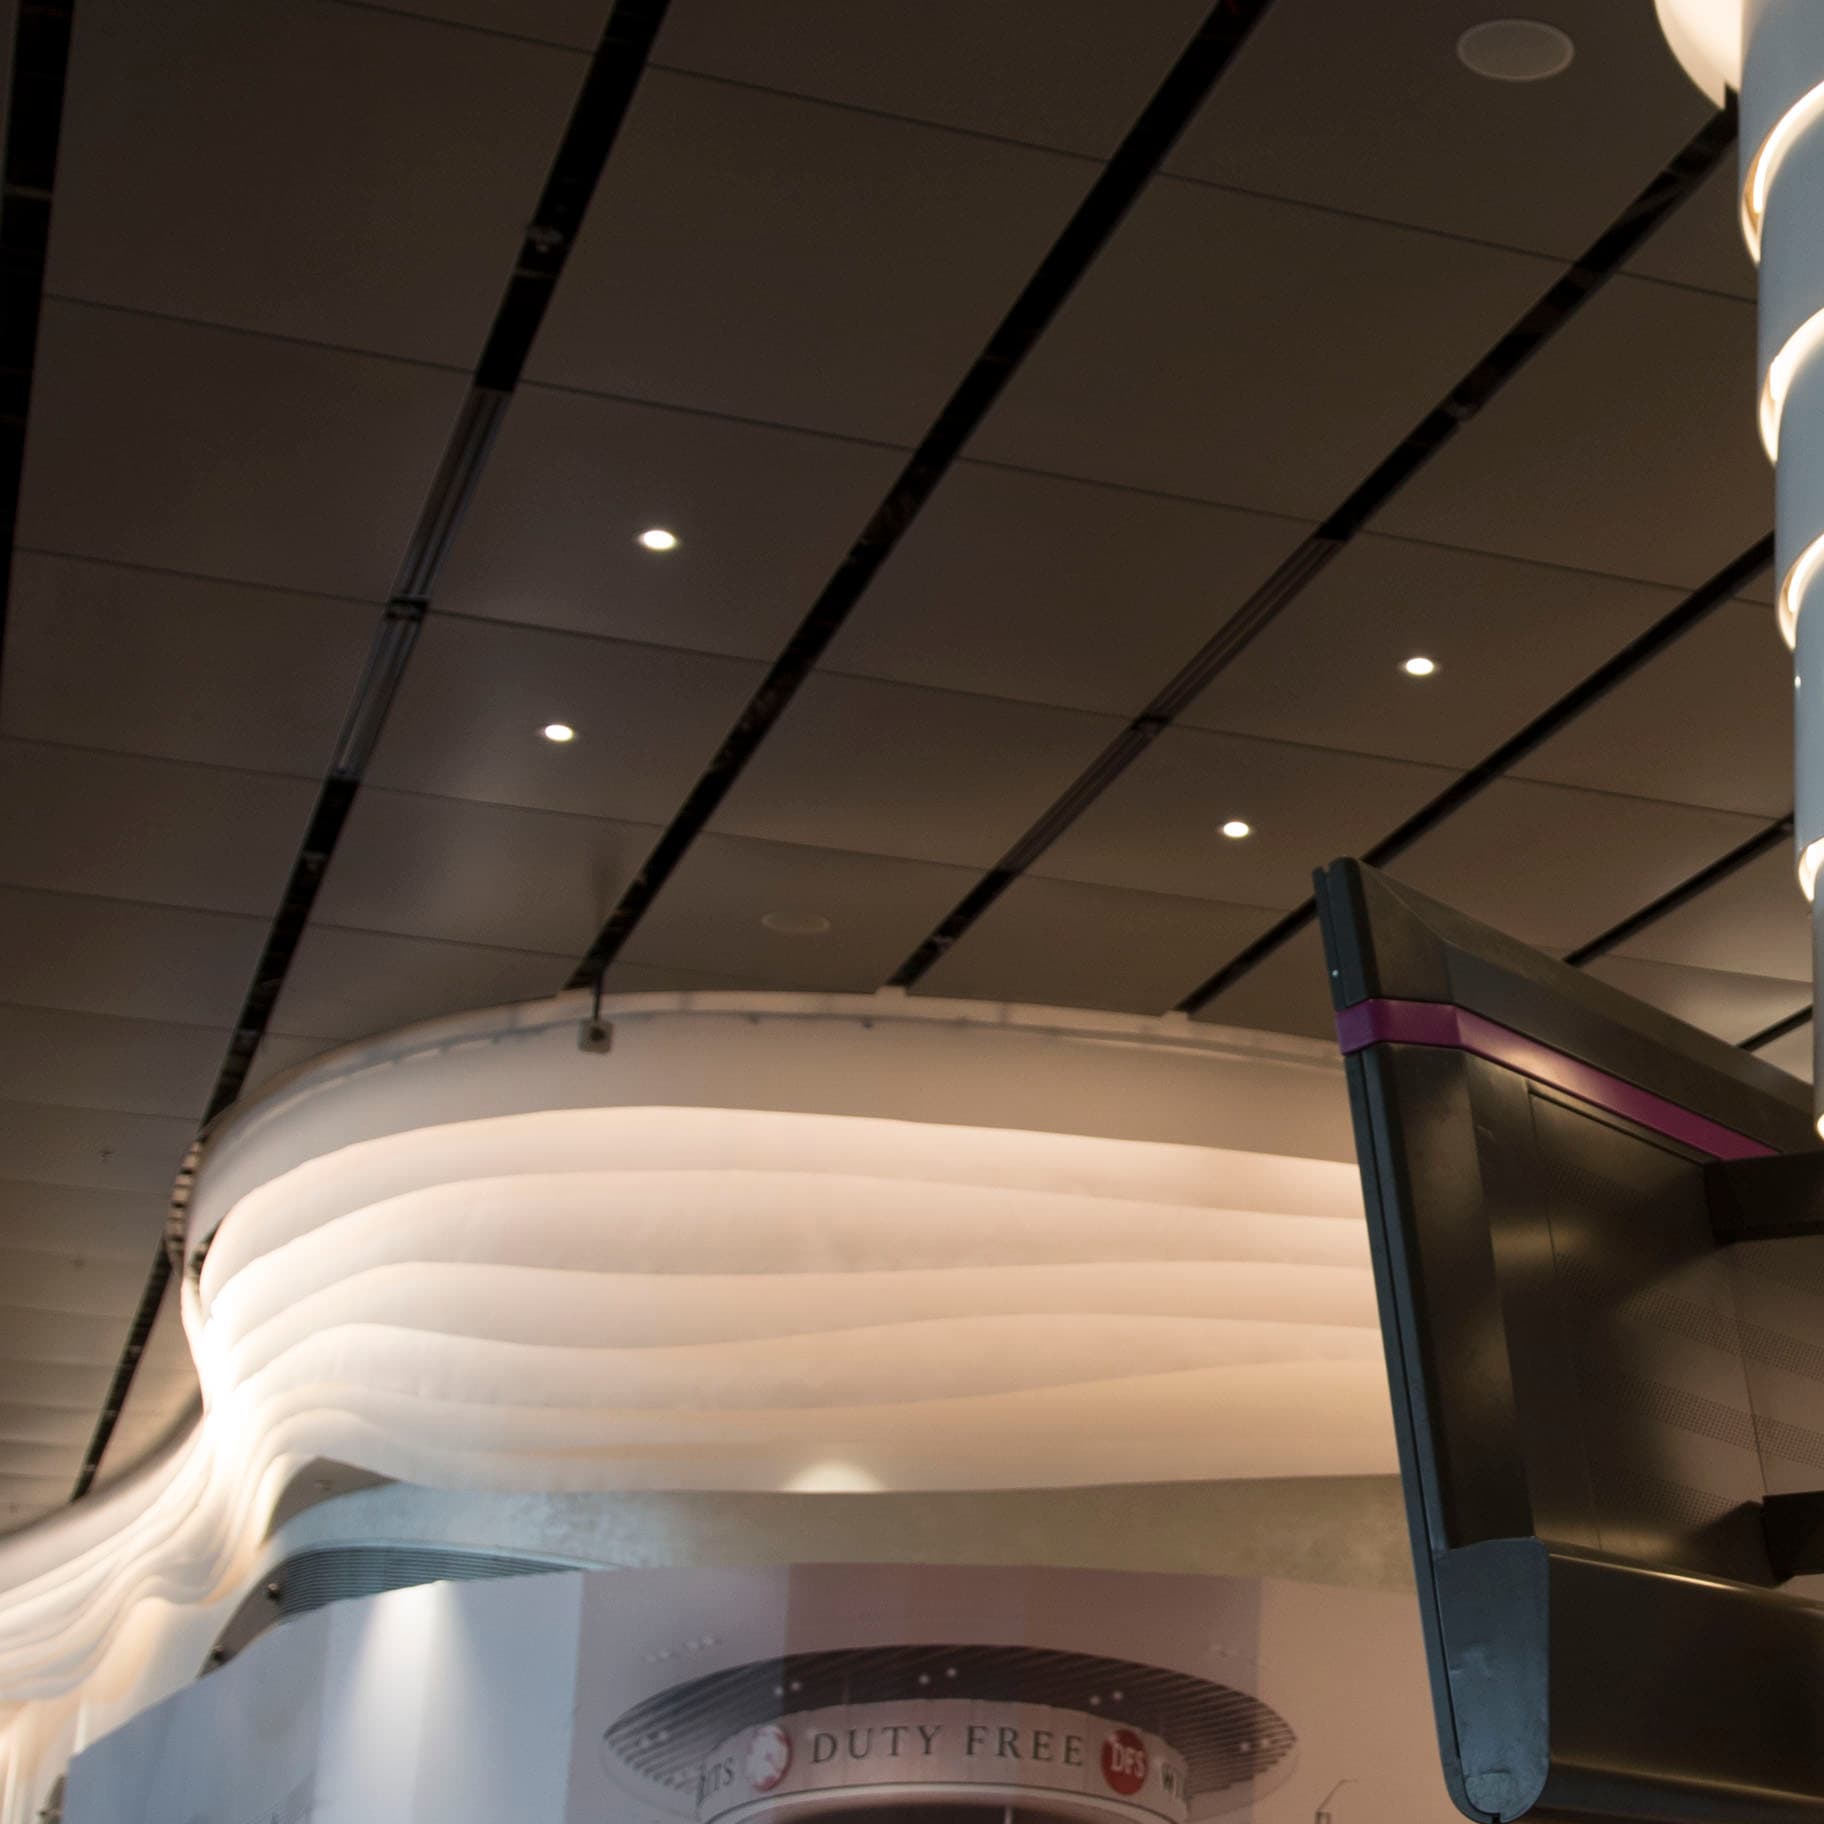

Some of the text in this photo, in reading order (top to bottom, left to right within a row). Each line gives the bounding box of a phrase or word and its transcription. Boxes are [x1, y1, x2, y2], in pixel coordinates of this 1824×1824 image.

[811, 1725, 945, 1764] DUTY
[965, 1724, 1085, 1767] FREE
[1110, 1742, 1145, 1778] DFS
